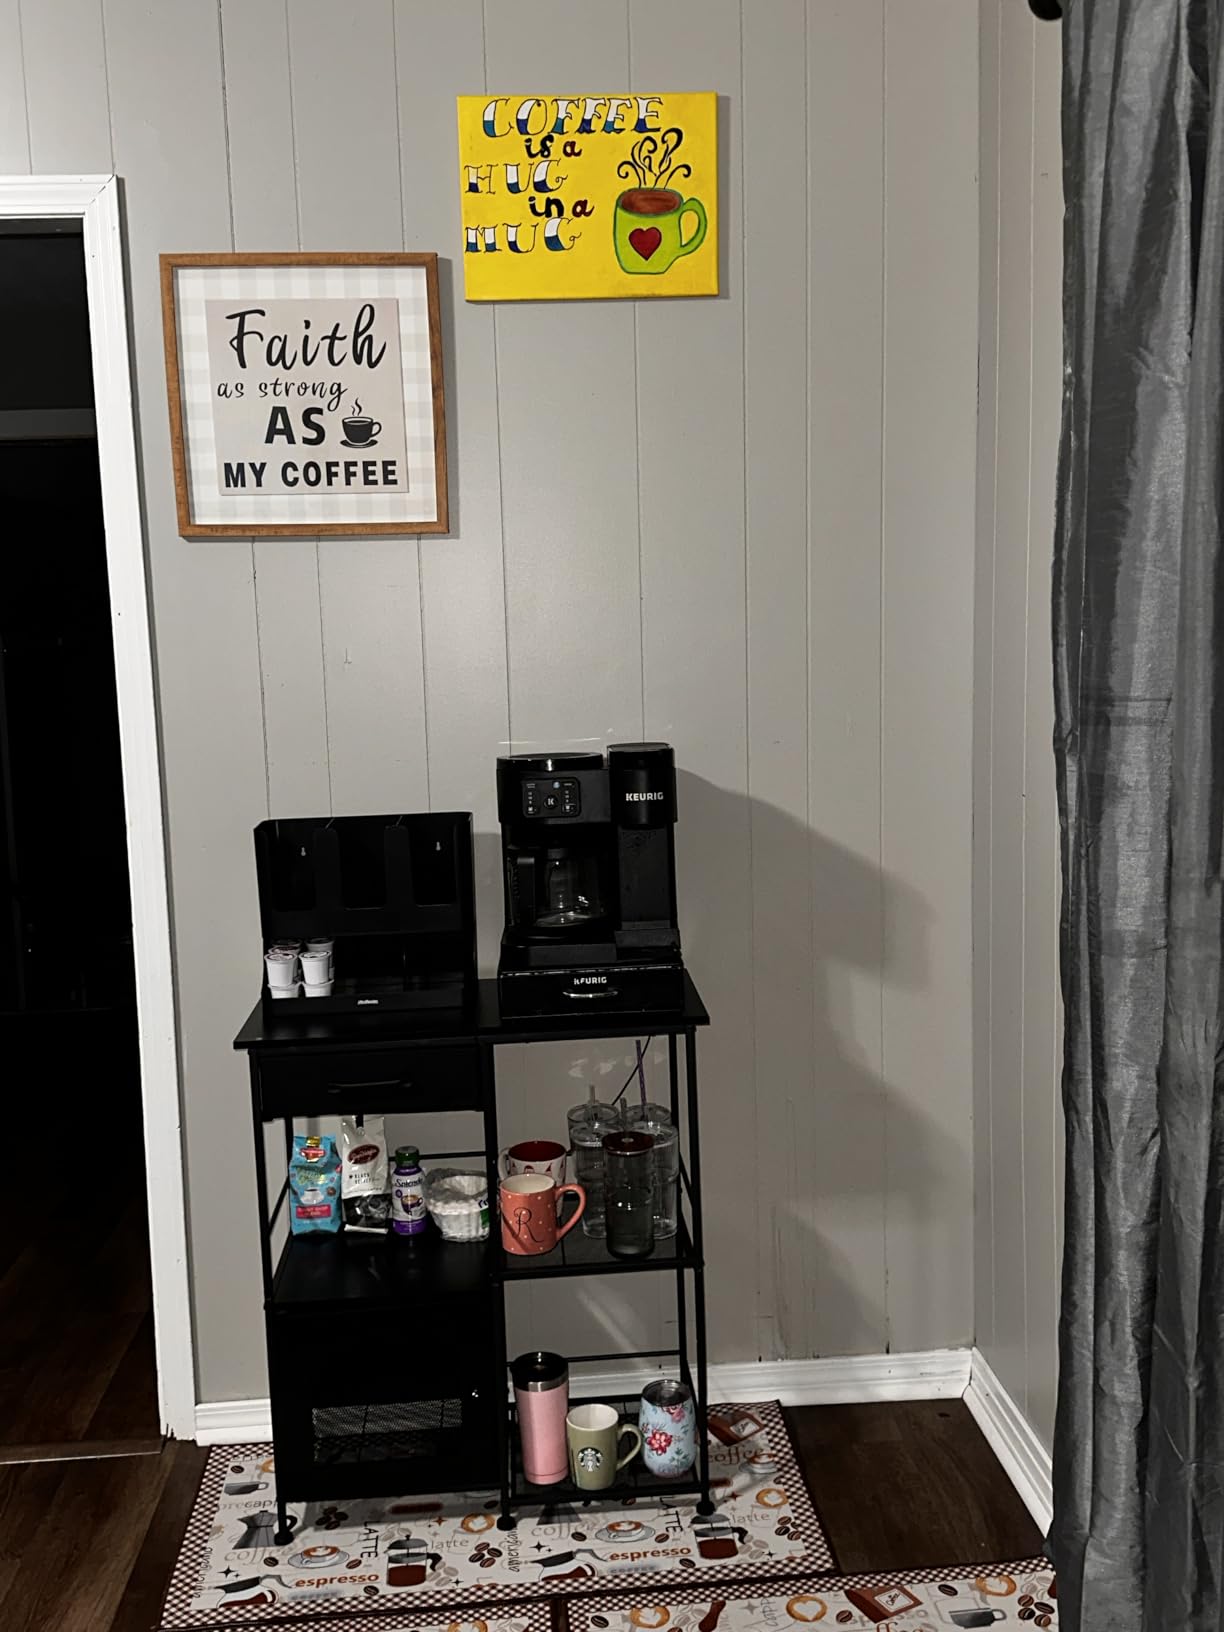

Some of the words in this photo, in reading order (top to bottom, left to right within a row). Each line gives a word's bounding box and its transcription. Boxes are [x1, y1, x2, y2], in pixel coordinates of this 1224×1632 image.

[482, 97, 663, 137] COFFEE
[524, 132, 554, 158] is
[562, 140, 582, 157] a
[464, 159, 568, 194] HUG
[528, 196, 564, 217] in
[572, 199, 594, 217] a
[464, 217, 582, 253] MUG
[225, 304, 387, 370] Faith
[217, 382, 245, 399] as
[258, 378, 348, 412] strong
[264, 405, 326, 446] AS
[223, 462, 267, 488] MY
[281, 460, 398, 487] COFFEE
[625, 791, 664, 802] KEURIG
[513, 1206, 545, 1243] R
[361, 1520, 381, 1559] LATTE
[609, 1547, 691, 1562] espresso
[295, 1574, 379, 1588] espresso
